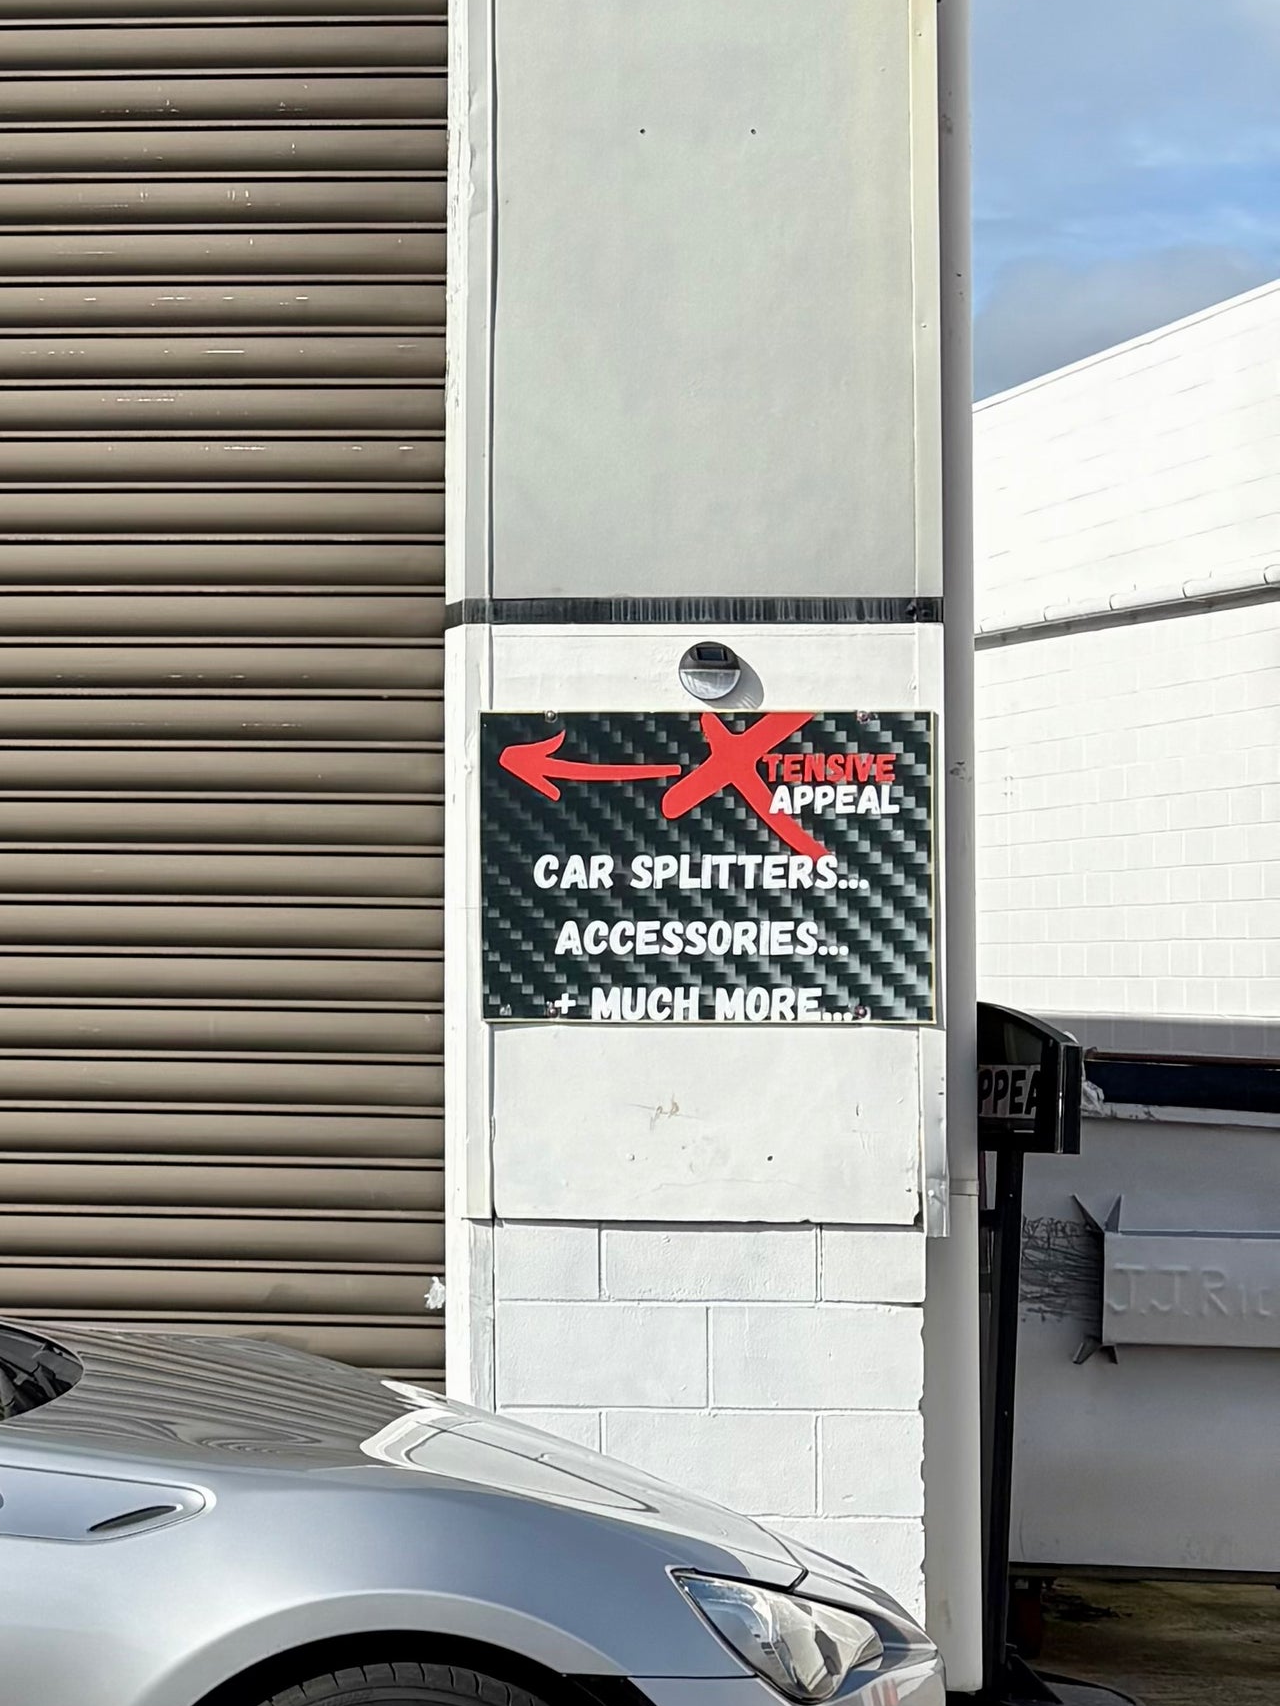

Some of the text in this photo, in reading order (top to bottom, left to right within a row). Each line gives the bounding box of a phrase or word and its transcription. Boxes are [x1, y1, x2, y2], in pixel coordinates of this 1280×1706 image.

[769, 784, 900, 814] APPEAL
[533, 854, 870, 890] CAR SPLITTERS...
[554, 920, 850, 956] ACCESSORIES...
[591, 986, 700, 1021] MUCH
[715, 986, 853, 1021] MORE...
